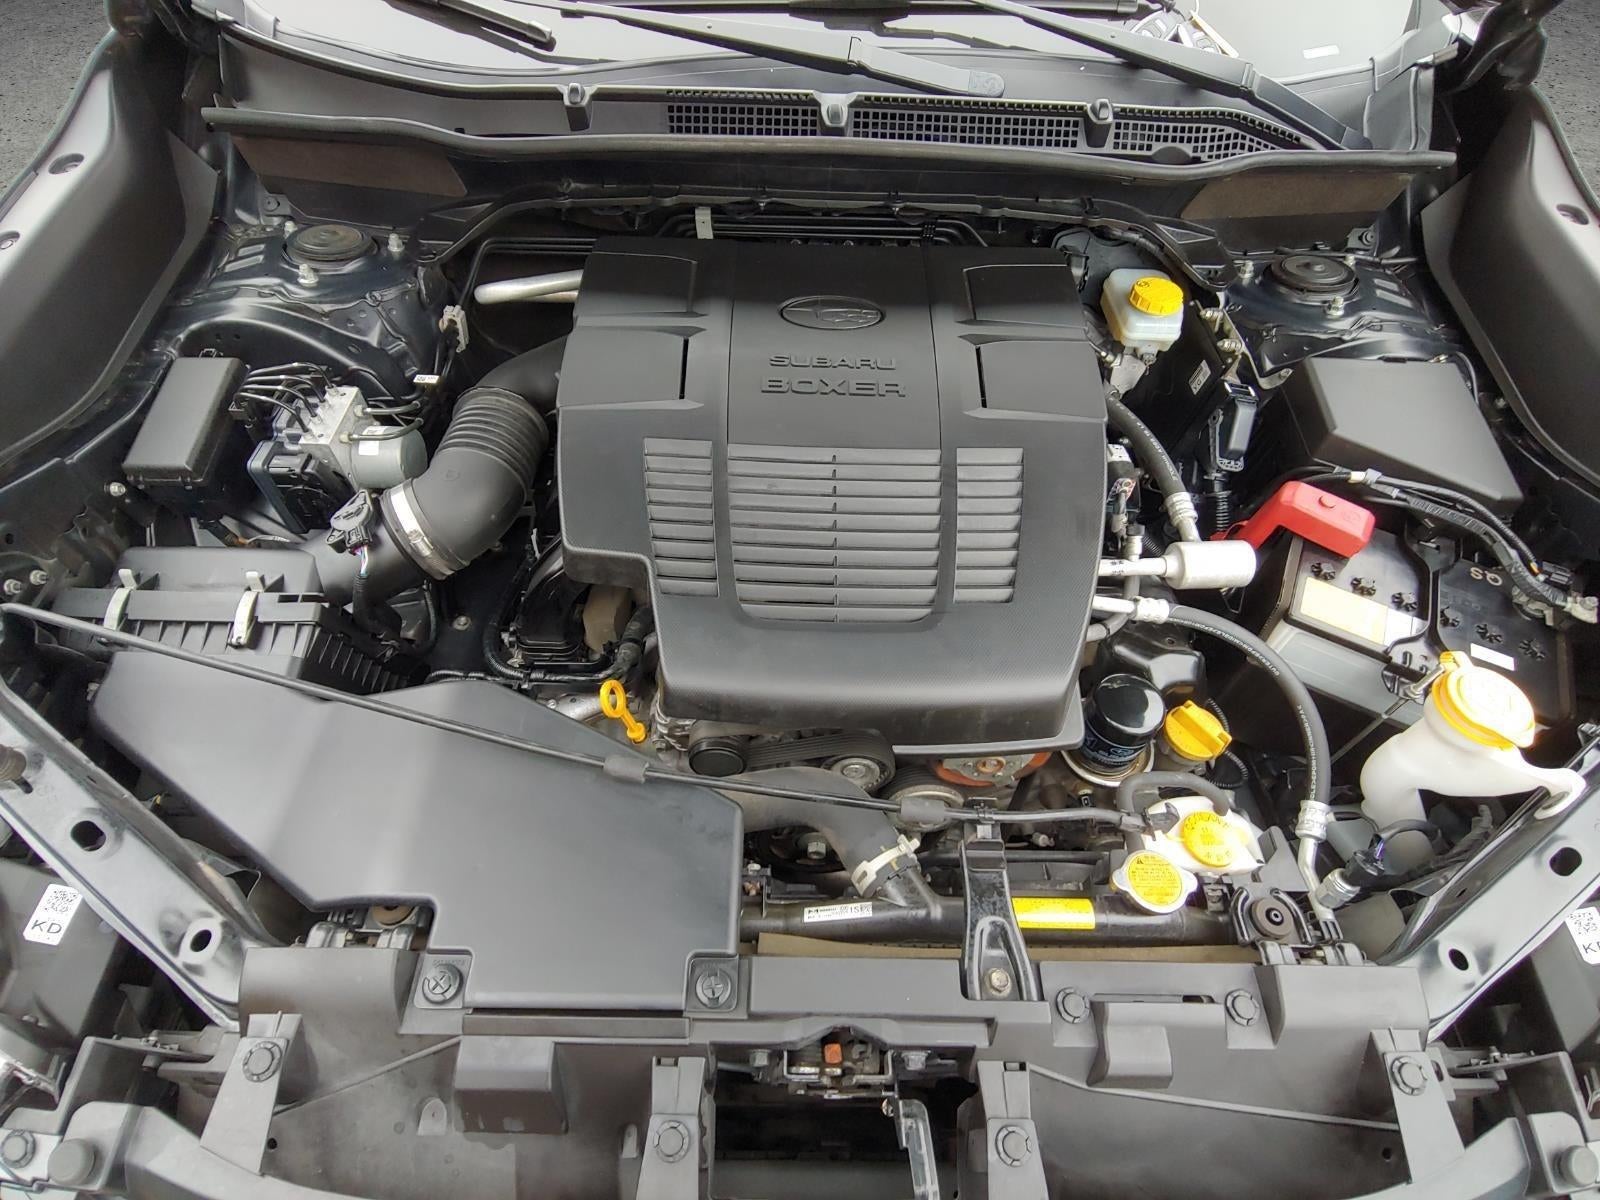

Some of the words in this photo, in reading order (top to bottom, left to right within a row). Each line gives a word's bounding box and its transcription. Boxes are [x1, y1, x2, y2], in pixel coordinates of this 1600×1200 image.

[769, 354, 897, 371] SUBARU
[760, 377, 907, 398] BOXER
[31, 919, 63, 934] KD
[1582, 940, 1600, 954] K
